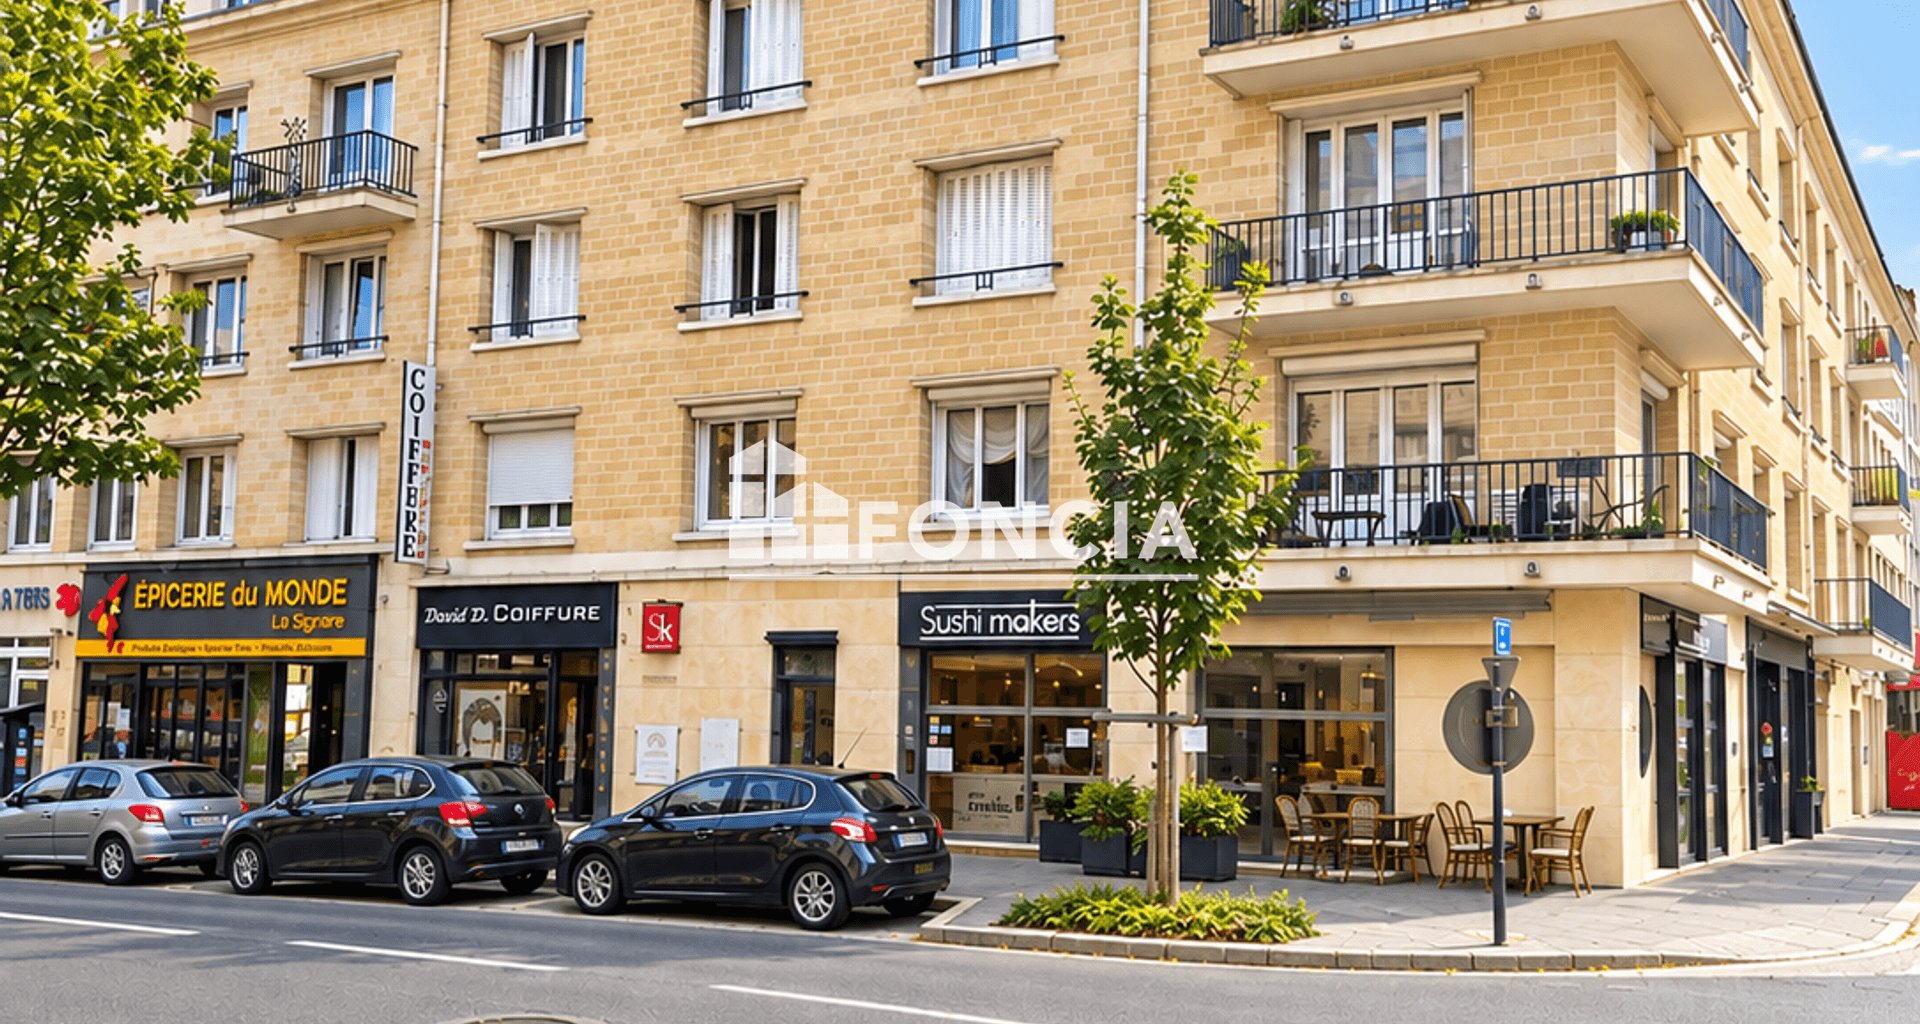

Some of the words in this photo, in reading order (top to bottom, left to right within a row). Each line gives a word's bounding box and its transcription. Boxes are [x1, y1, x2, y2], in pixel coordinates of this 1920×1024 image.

[134, 579, 226, 609] ÉPICERIE
[231, 579, 258, 606] du
[265, 578, 348, 606] MONDE
[470, 606, 489, 623] D.
[493, 603, 600, 622] COIFFURE
[647, 612, 673, 643] Sk
[920, 604, 982, 634] Sushi
[989, 598, 1081, 634] makers
